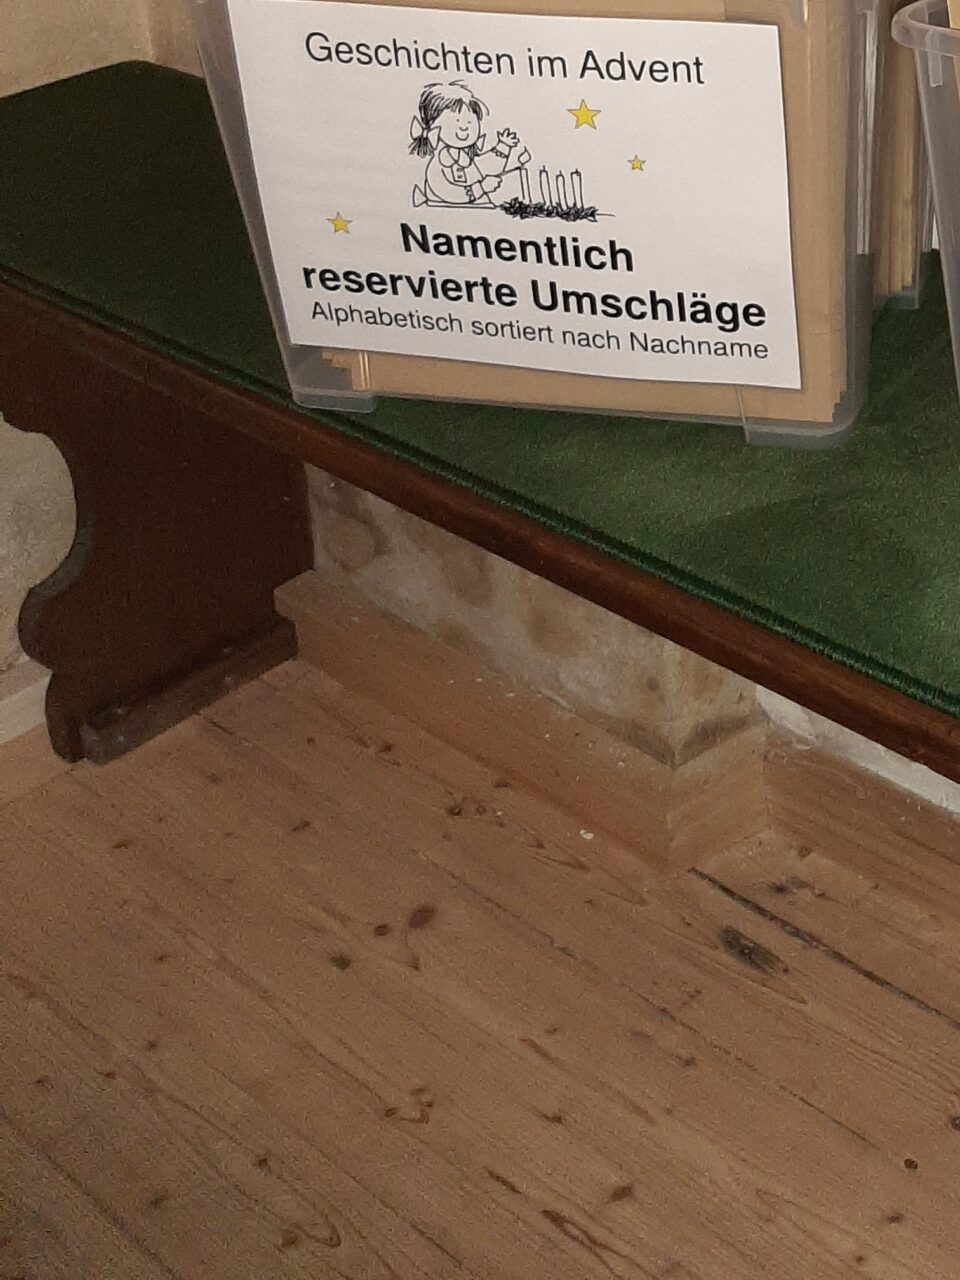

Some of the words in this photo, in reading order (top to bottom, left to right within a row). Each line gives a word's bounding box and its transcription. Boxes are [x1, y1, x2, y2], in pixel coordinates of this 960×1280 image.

[306, 33, 514, 74] Geschichten
[528, 48, 566, 77] im
[580, 51, 704, 83] Advent
[401, 223, 633, 271] Namentlich
[303, 267, 517, 306] reservierte
[531, 280, 765, 332] Umschläge
[312, 302, 462, 332] Alphabetisch
[472, 321, 553, 343] sortiert
[563, 330, 620, 349] nach
[630, 332, 768, 358] Nachname
